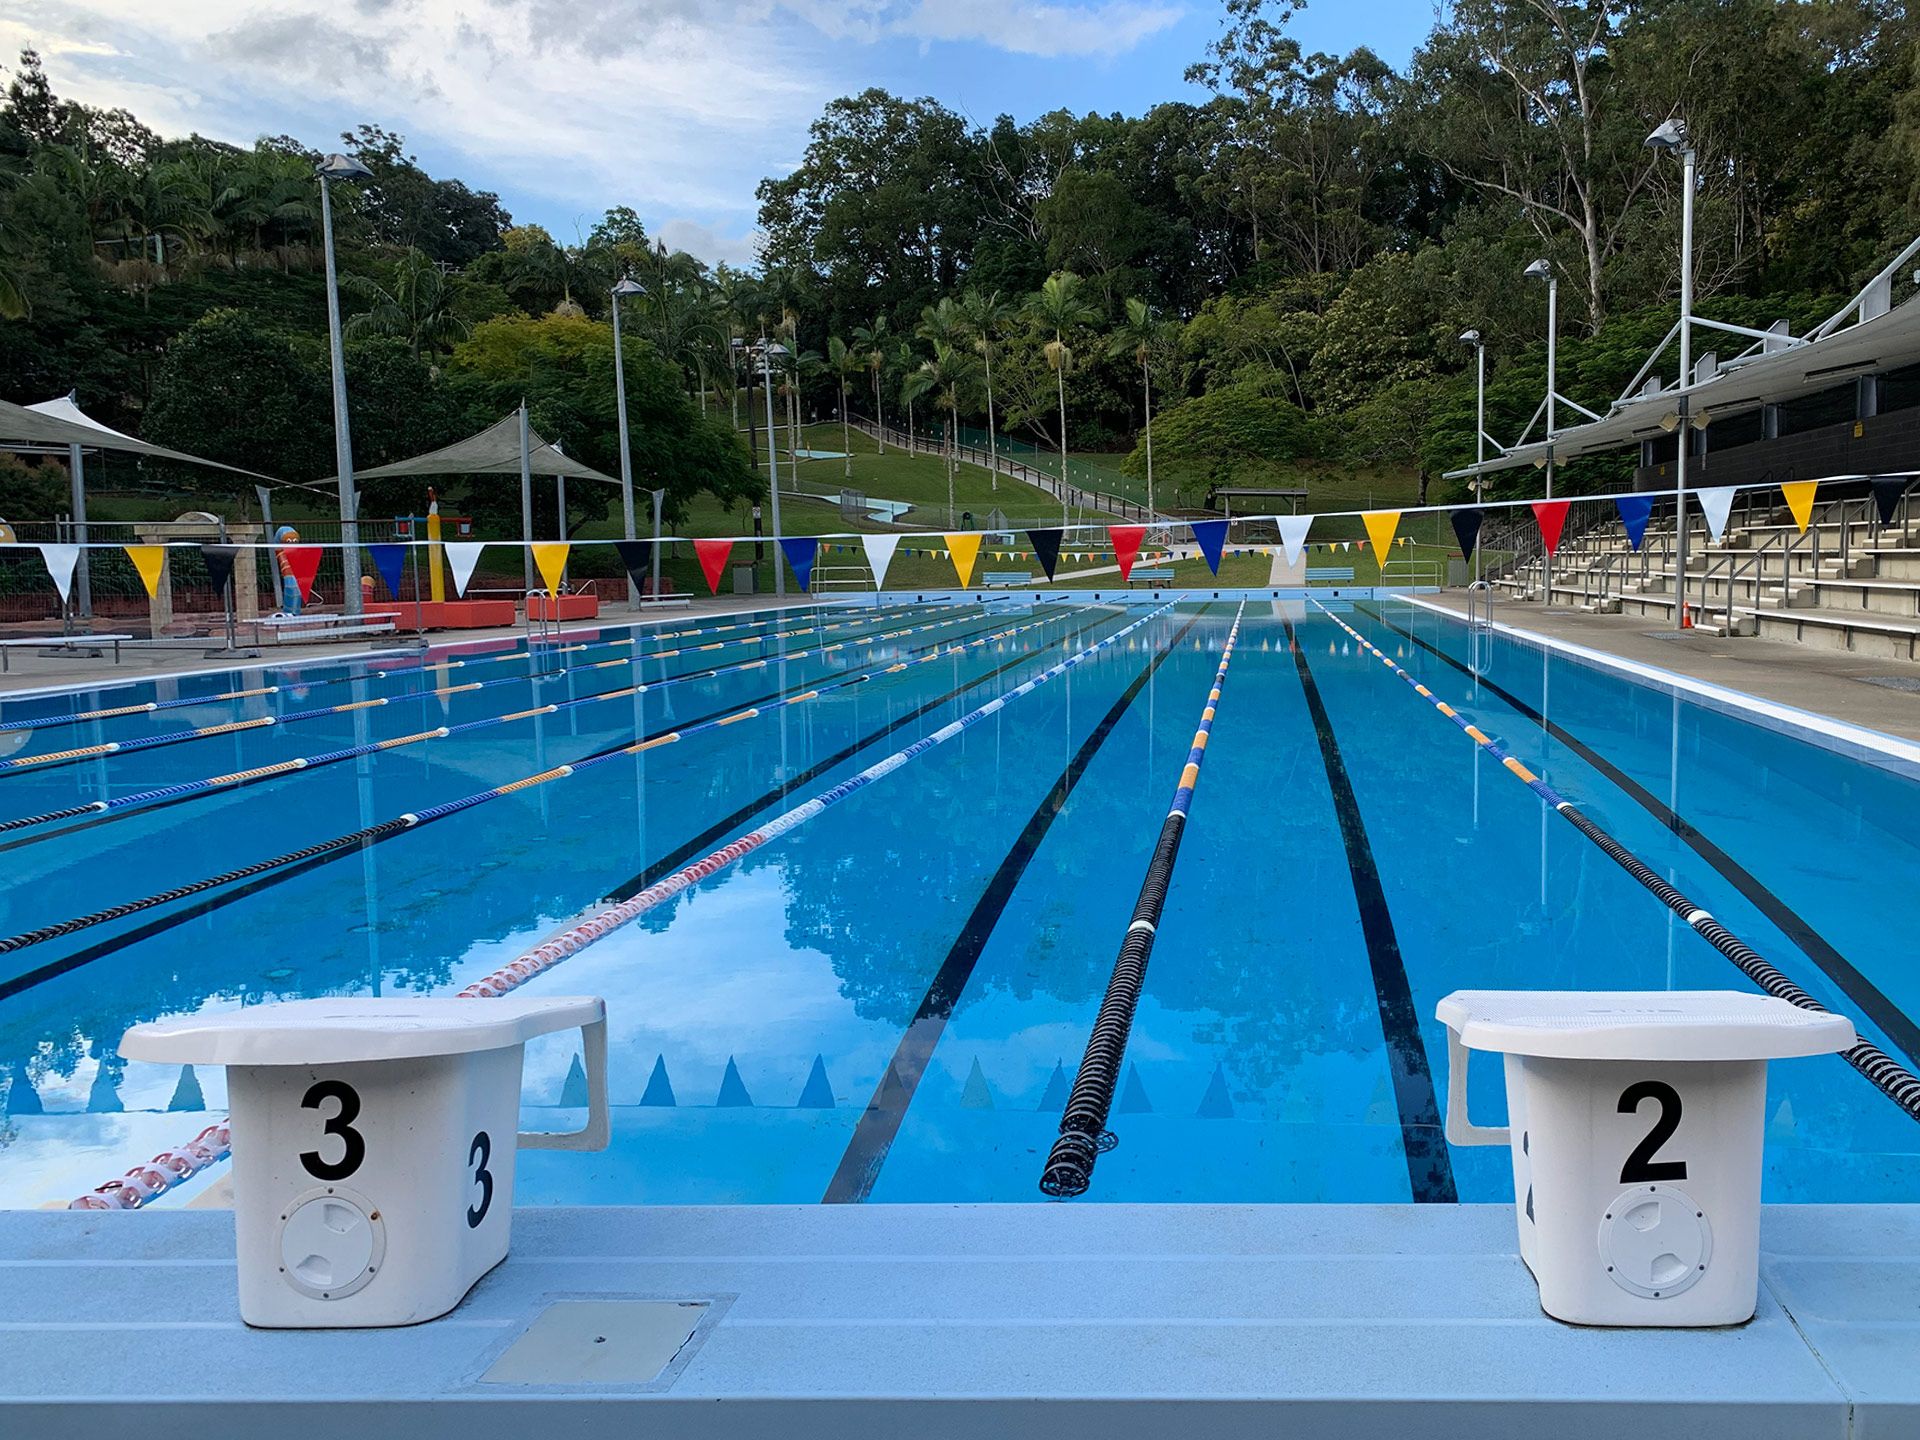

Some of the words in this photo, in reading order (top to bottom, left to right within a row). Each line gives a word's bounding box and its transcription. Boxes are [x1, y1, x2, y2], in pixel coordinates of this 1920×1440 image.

[299, 1079, 366, 1182] 3
[466, 1131, 494, 1229] 3
[1616, 1080, 1688, 1184] 2
